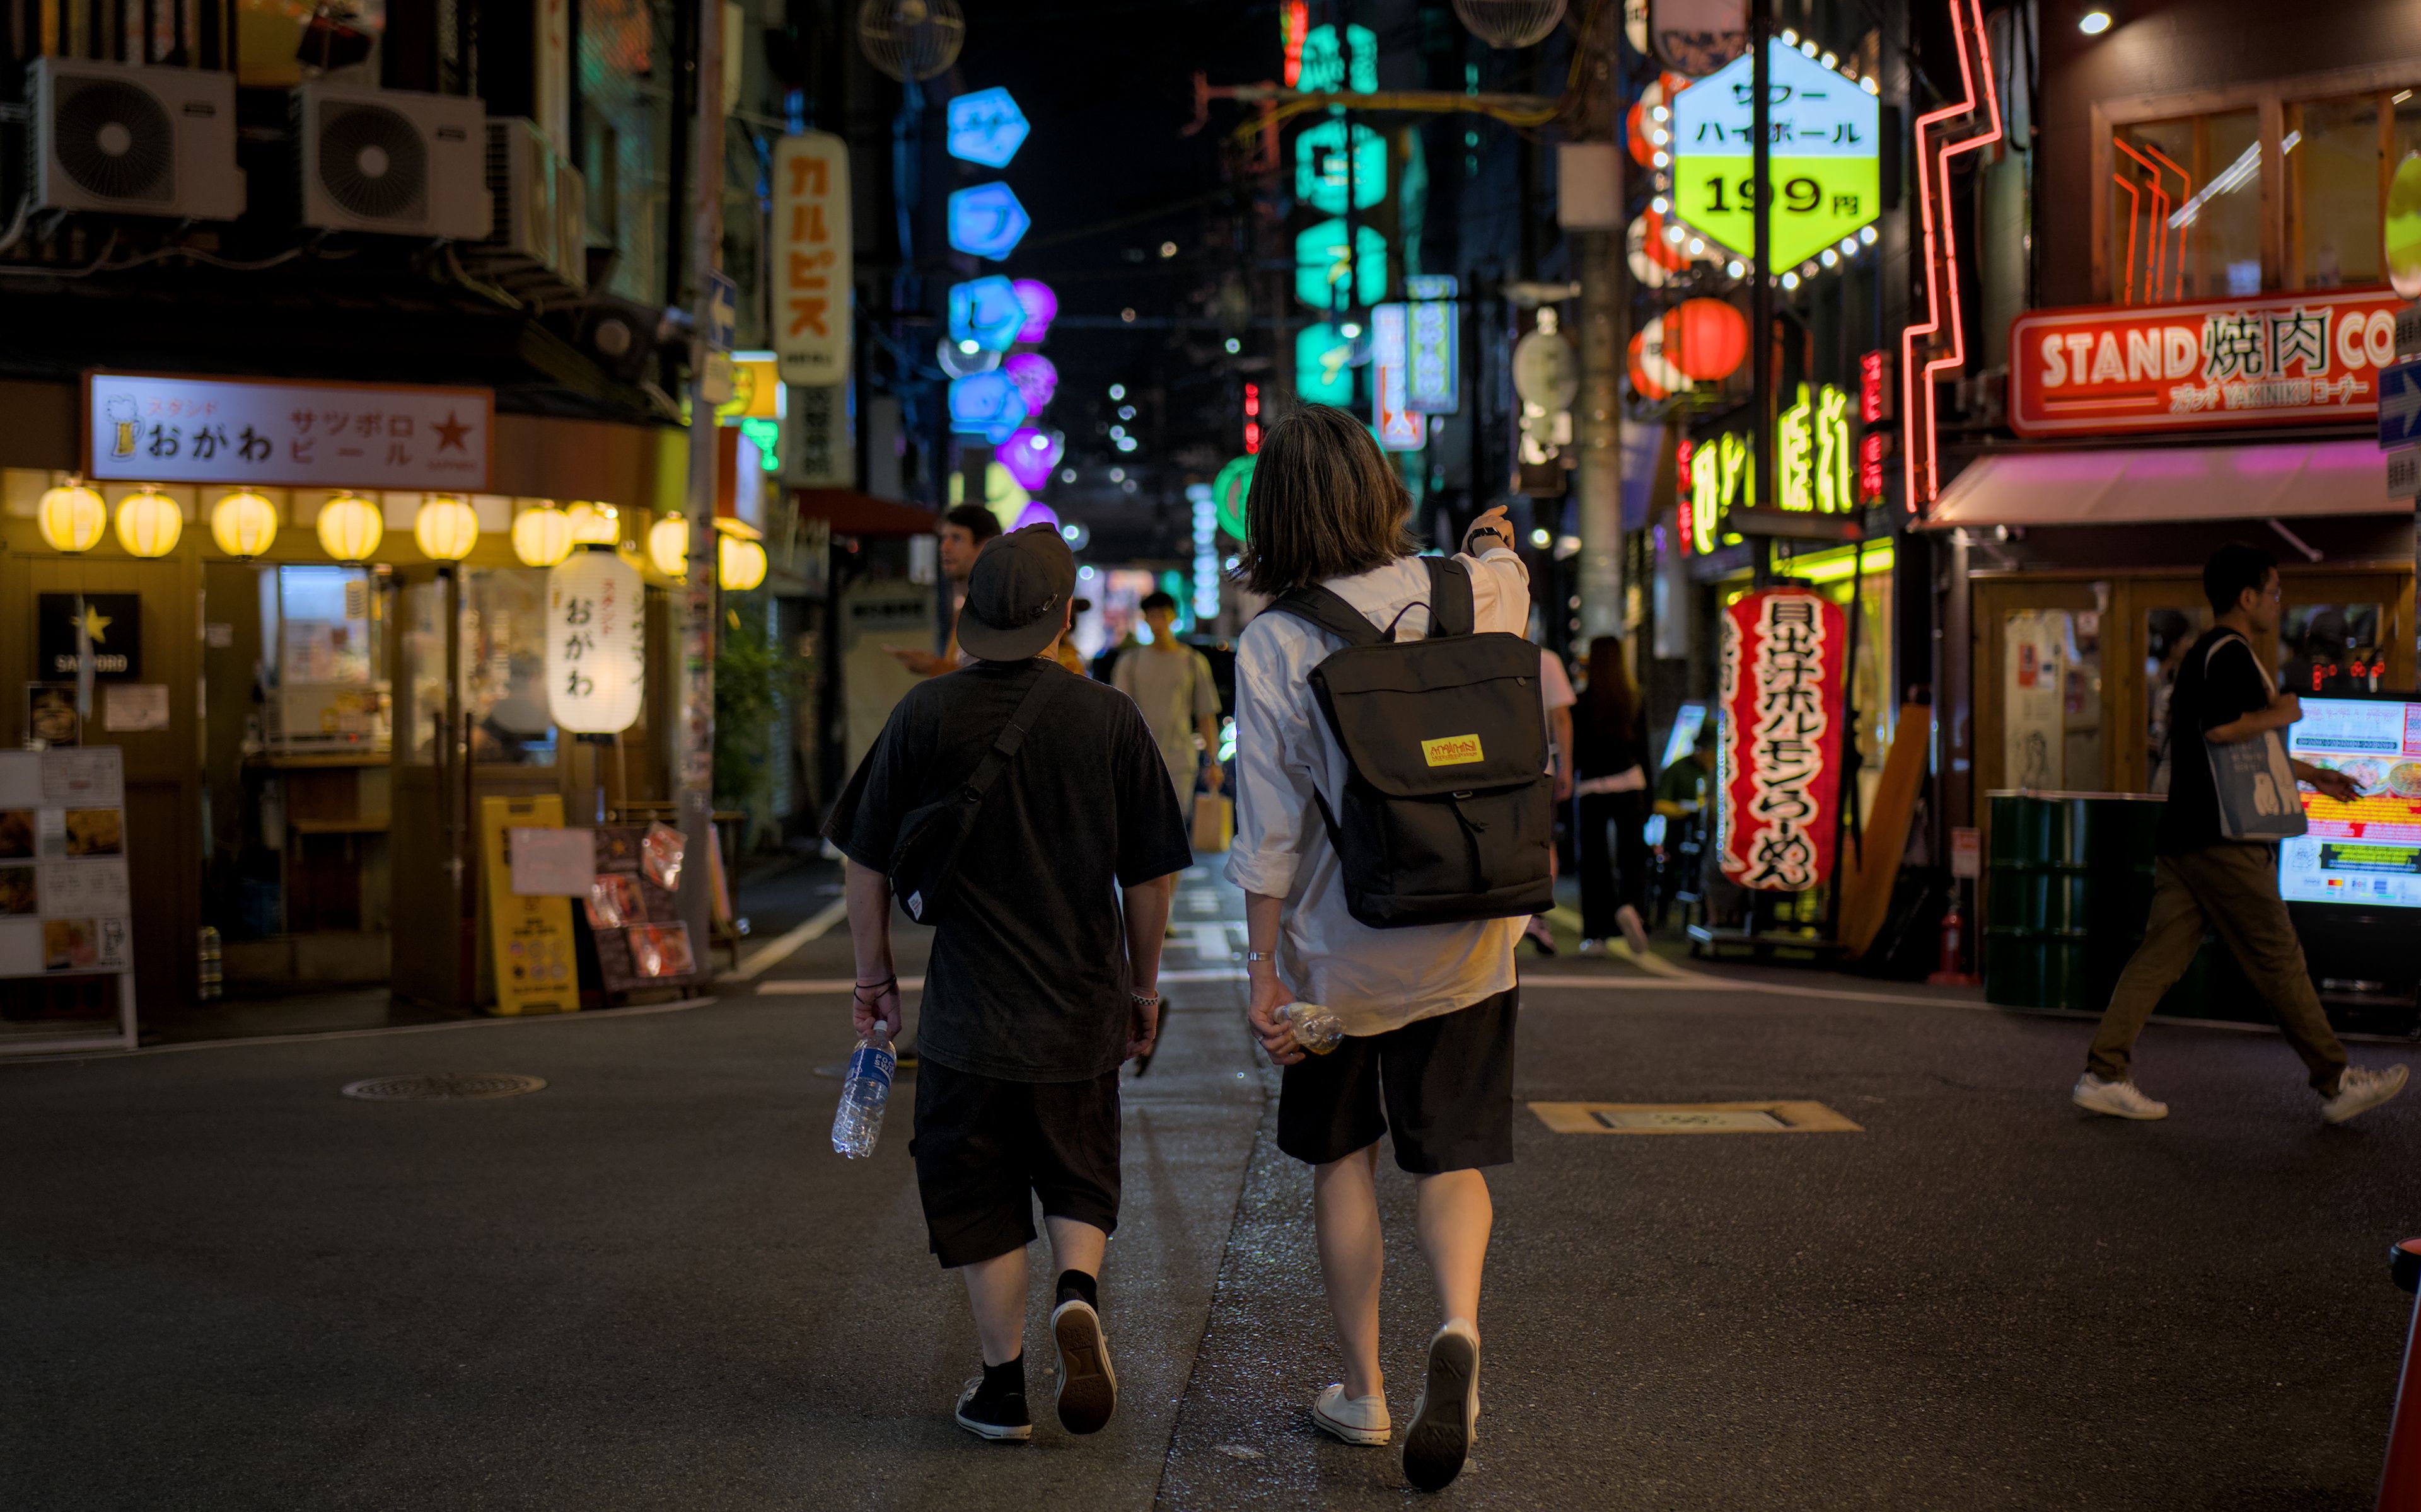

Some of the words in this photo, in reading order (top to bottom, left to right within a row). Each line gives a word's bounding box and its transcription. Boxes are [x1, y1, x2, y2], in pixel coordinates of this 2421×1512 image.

[1696, 118, 1861, 143] ハイボール
[787, 155, 836, 338] カルピス
[2040, 325, 2198, 387] STAND
[2204, 306, 2331, 380] 焼肉
[2223, 377, 2312, 410] YAKINIKU
[2313, 372, 2369, 407] コーナー
[148, 422, 274, 463] おがわ
[291, 437, 413, 466] ビール
[54, 654, 129, 673] SAORO
[564, 595, 595, 697] おがわ
